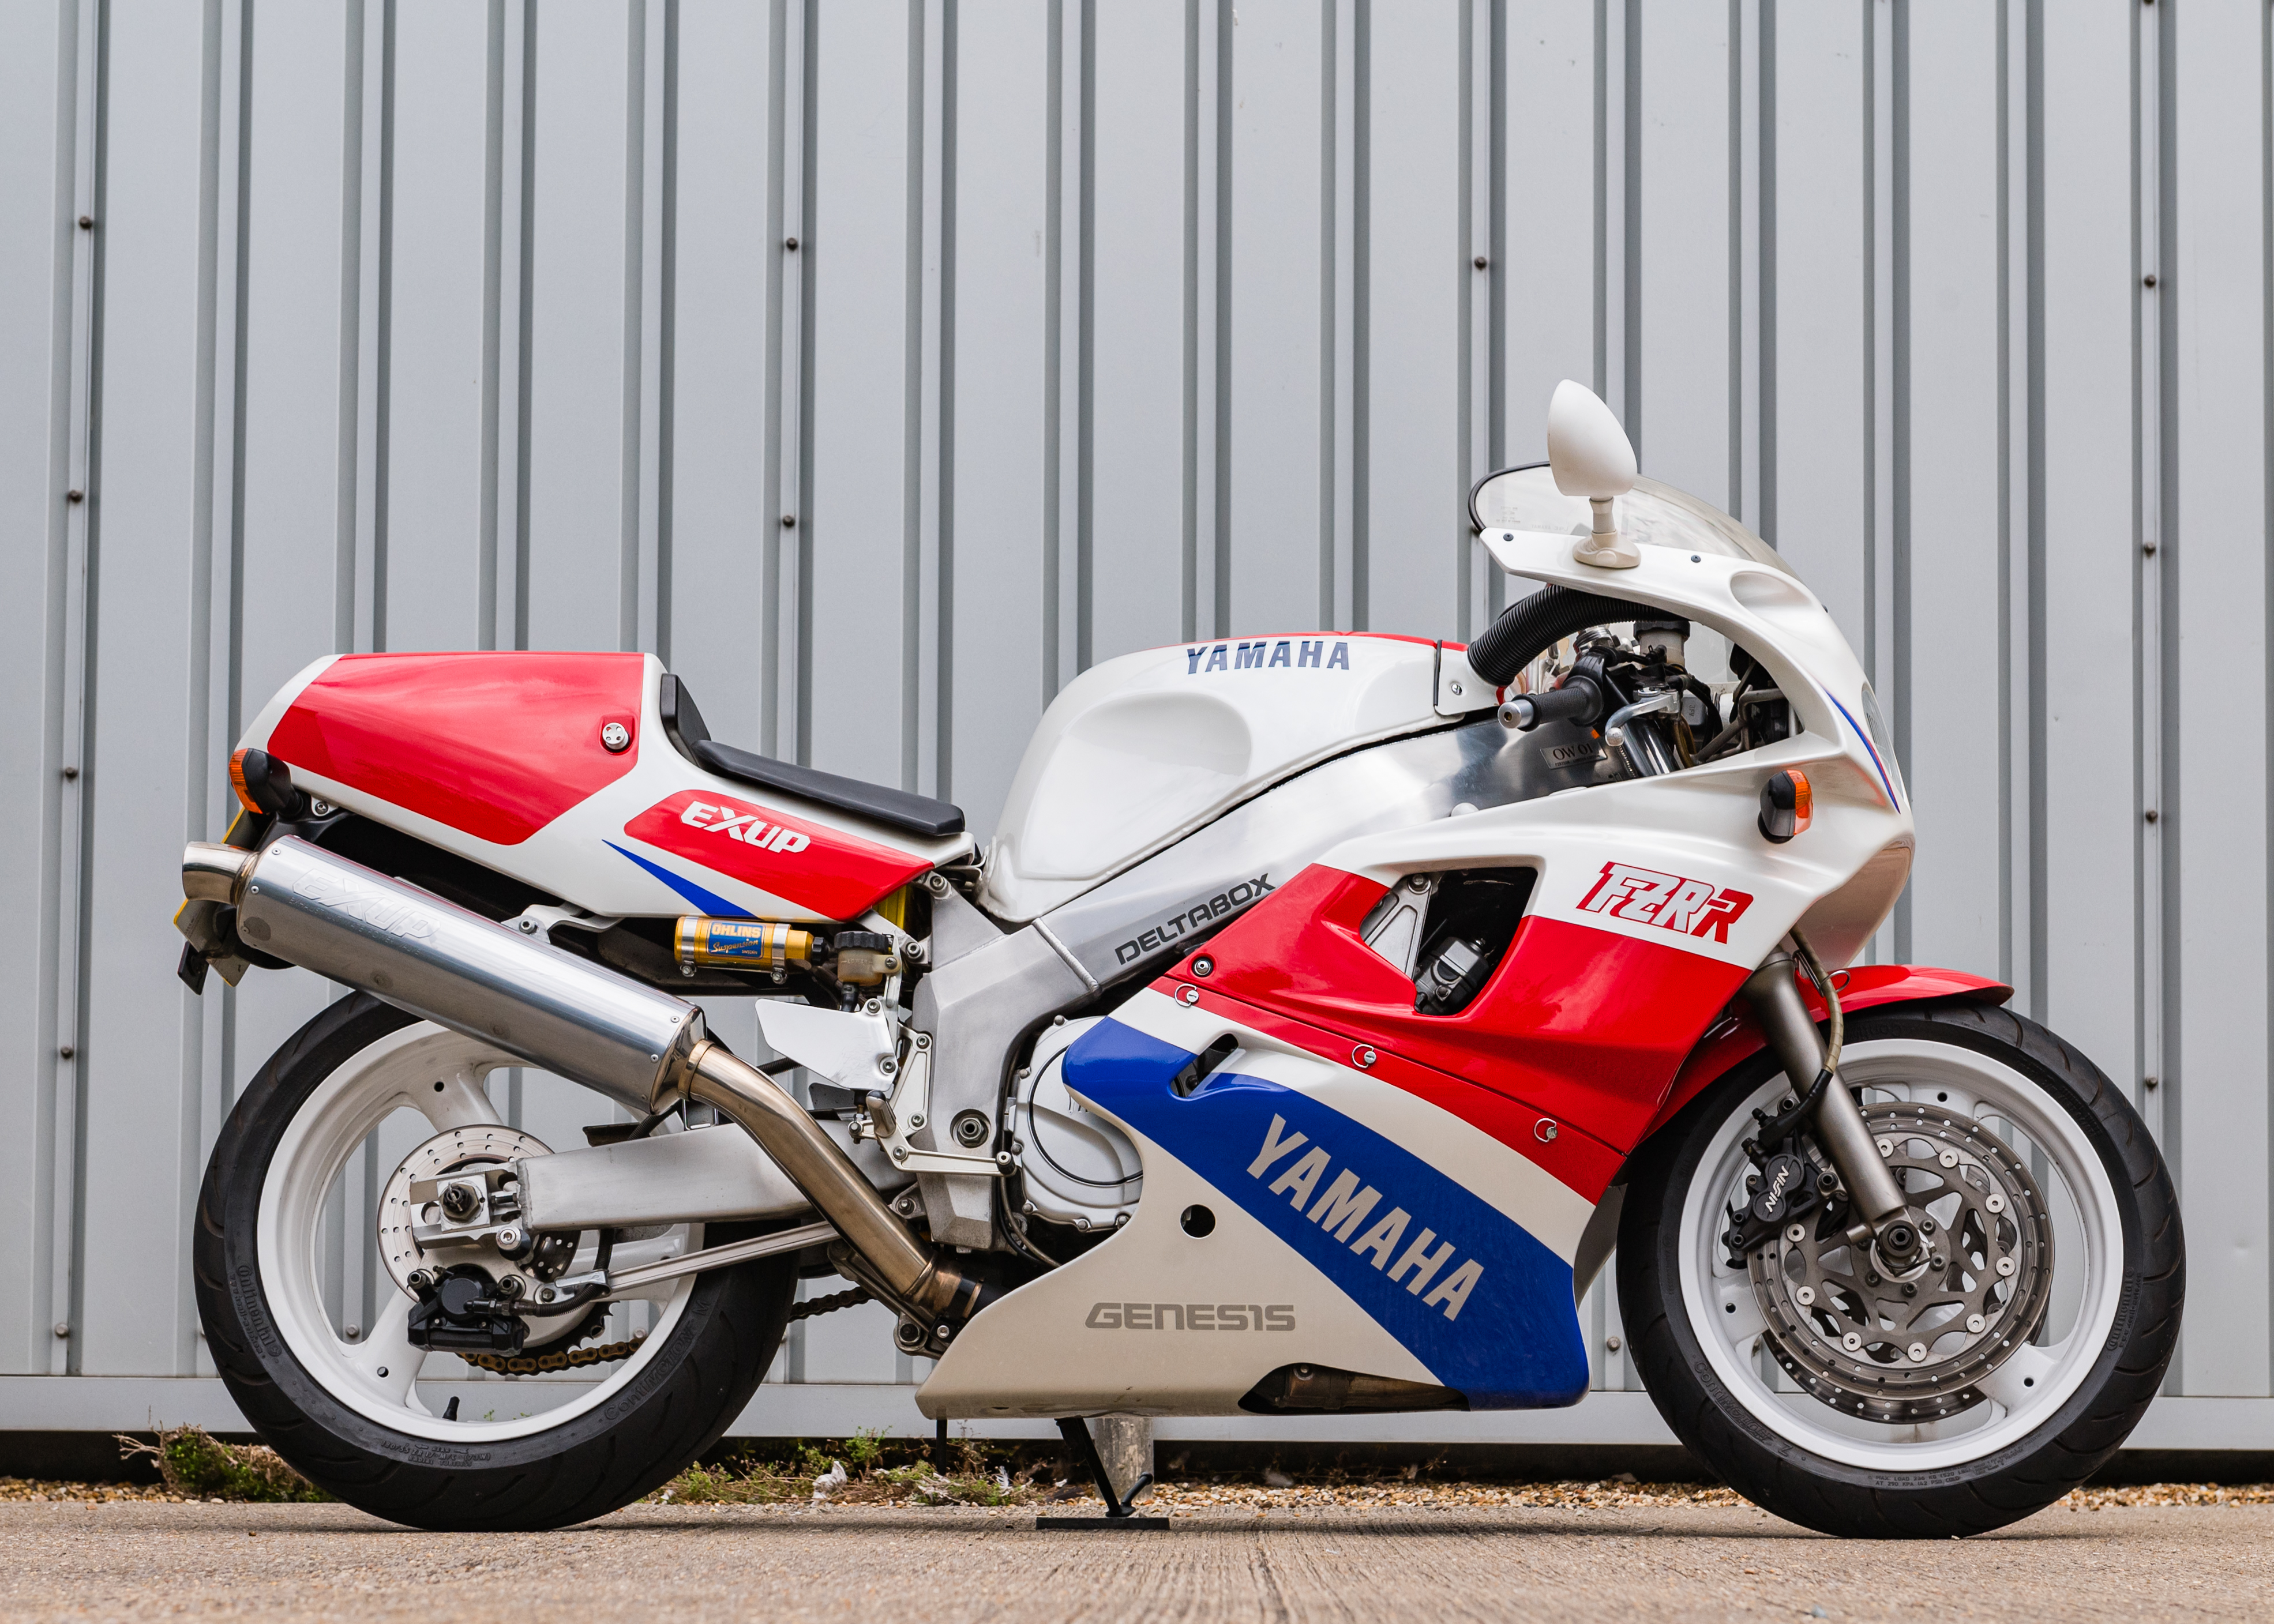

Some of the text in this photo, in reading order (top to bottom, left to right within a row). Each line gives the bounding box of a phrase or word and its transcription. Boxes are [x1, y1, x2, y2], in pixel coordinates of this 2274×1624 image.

[1187, 641, 1350, 675] YAMAHA
[1552, 746, 1575, 760] OW
[681, 800, 811, 853] EXUP
[292, 868, 441, 939] EXUP
[1114, 873, 1276, 965] DELTABOX
[710, 938, 759, 953] Suspension
[1765, 1165, 1789, 1213] NISSIN
[1247, 1114, 1484, 1321] YAMAHA
[1085, 1302, 1296, 1332] GENESIS
